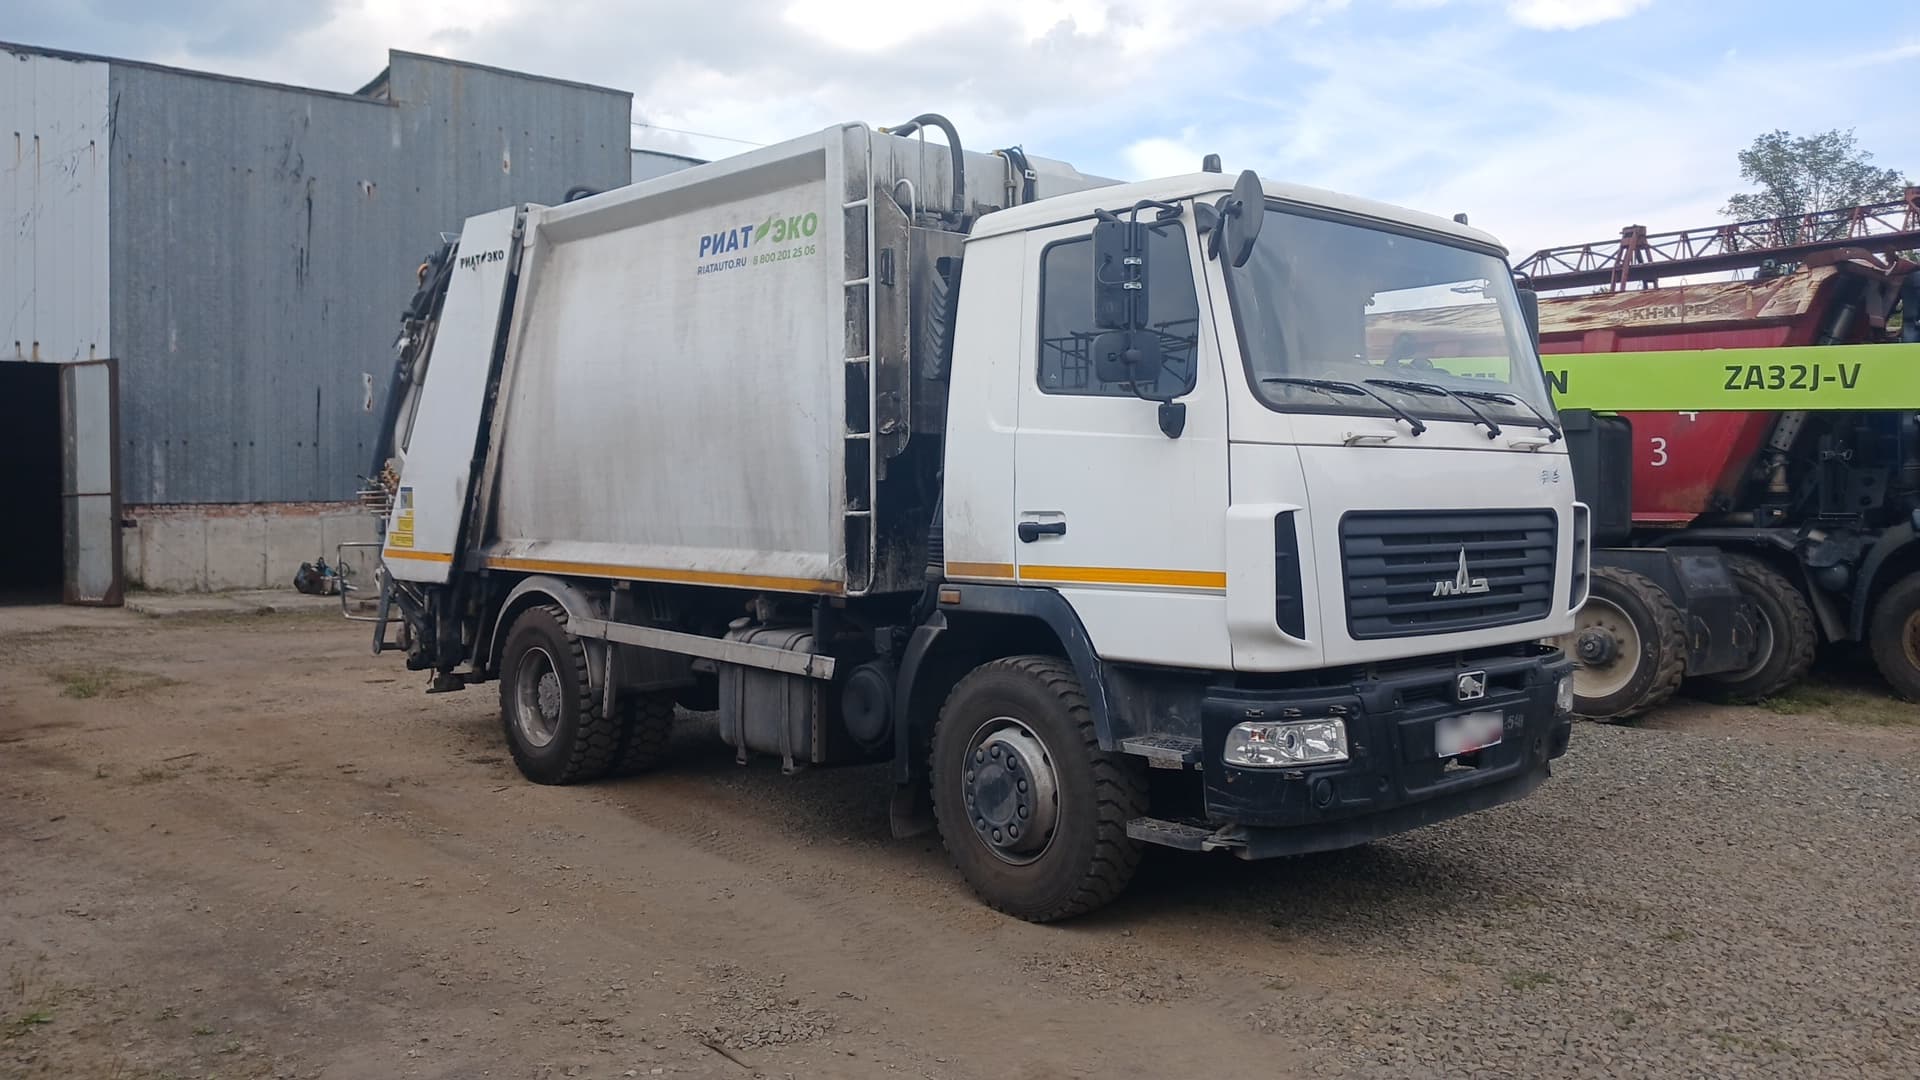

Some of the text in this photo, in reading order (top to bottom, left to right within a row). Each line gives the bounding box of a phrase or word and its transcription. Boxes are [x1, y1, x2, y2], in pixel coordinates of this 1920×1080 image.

[699, 212, 818, 258] РИАТ ЭКО
[697, 257, 747, 276] RIATAUTO.RU
[1723, 363, 1862, 392] ZA32J-V
[1650, 437, 1668, 466] 3
